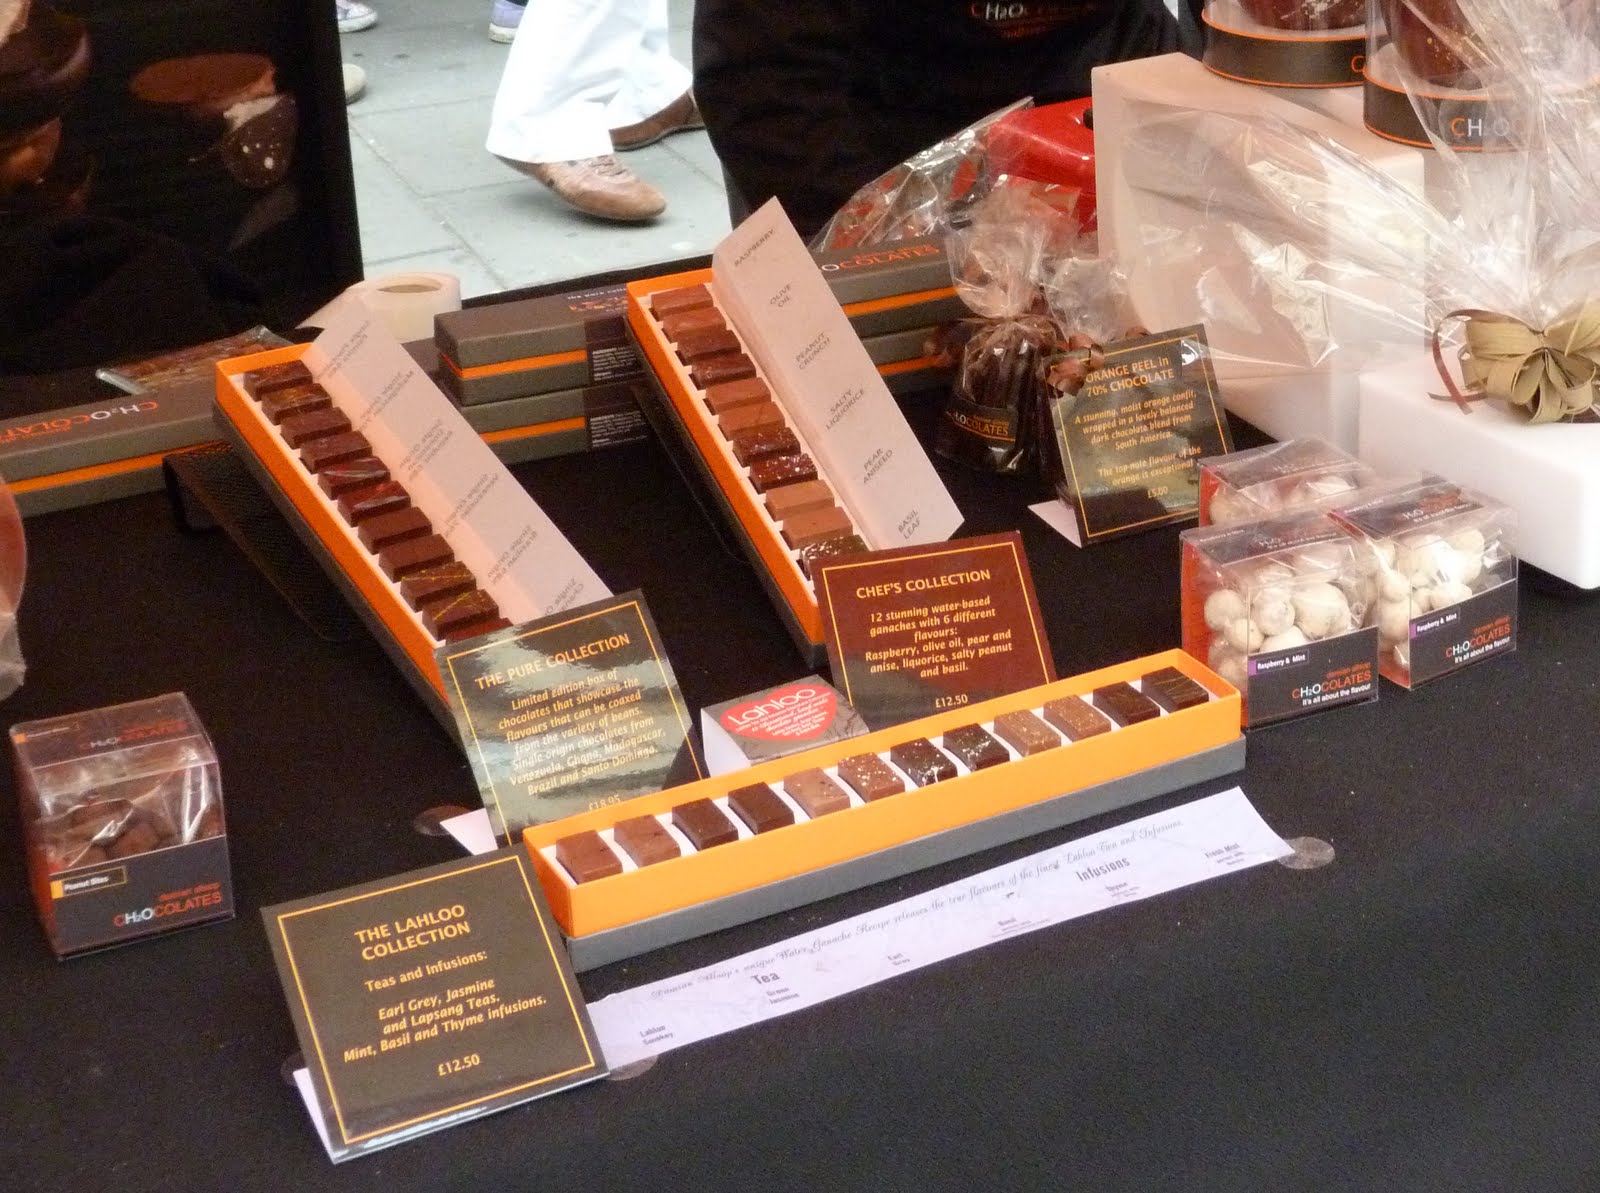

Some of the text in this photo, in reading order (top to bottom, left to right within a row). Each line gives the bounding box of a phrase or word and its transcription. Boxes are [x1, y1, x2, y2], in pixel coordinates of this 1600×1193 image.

[734, 228, 775, 267] RASPBERRY
[770, 284, 792, 306] OLIVE
[778, 296, 791, 308] OIL
[796, 332, 825, 362] PEANUT
[799, 337, 831, 370] CRUNCH
[1085, 357, 1169, 384] ORANGE PEEL in
[1086, 368, 1175, 398] 70% CHOCOLATE
[826, 388, 866, 430] LIQUORICE
[830, 388, 853, 413] SALTY
[1074, 416, 1081, 425] A
[1120, 402, 1142, 414] moist
[1143, 396, 1171, 409] orange
[1082, 419, 1117, 435] wrapped
[1118, 418, 1127, 426] in
[1135, 410, 1158, 422] lovely
[1159, 401, 1194, 417] balanced
[1091, 414, 1192, 445] dark chocolate blend from
[1115, 430, 1173, 451] South America.
[863, 450, 894, 484] ANISEED
[864, 448, 883, 471] PEAR
[1098, 468, 1113, 478] The
[1178, 449, 1187, 459] of
[1189, 446, 1201, 456] the
[1112, 459, 1194, 487] orange is exceptional
[898, 509, 919, 534] BASIL
[904, 518, 922, 540] LEAF
[855, 569, 991, 599] CHEF'S COLLECTION
[869, 608, 996, 638] ganaches with 6 different
[870, 595, 991, 623] 12 stunning water-based
[865, 629, 1012, 662] Raspberry, olive oil, pear and
[913, 627, 959, 643] flavours:
[1470, 646, 1484, 658] about
[1485, 643, 1493, 652] the
[1494, 636, 1510, 648] flavour
[474, 633, 631, 690] THE PURE COLLECTION
[870, 642, 1013, 674] anise, liquorice, salty peanut
[920, 661, 969, 678] and basil.
[1257, 659, 1285, 670] Raspberry
[1292, 654, 1305, 663] Mint
[498, 677, 640, 730] chocolates that showcase the
[511, 667, 619, 711] Limited edition box of
[935, 694, 968, 708] £12.50
[1322, 692, 1339, 702] about
[1340, 689, 1349, 697] the
[1351, 684, 1371, 694] flavour
[506, 689, 642, 744] flavours that can be coaxed
[727, 689, 816, 726] Lahloo
[511, 716, 655, 772] Single origin chocolates from
[514, 706, 643, 756] from the variety of beans.
[509, 727, 667, 787] Venezuela, Ghana, Madagascar,
[527, 745, 659, 796] Brazil and Santo Domingo.
[1075, 857, 1131, 883] Infusions
[353, 904, 466, 944] THE LAHLOO
[361, 921, 471, 961] COLLECTION
[364, 950, 488, 992] Teas and Infusions:
[750, 968, 781, 986] Tea
[378, 978, 496, 1021] Earl Grey, Jasmine
[382, 993, 501, 1035] and Lapsang Teas.
[343, 994, 548, 1064] Mint, Basil and Thyme infusions.
[437, 1053, 481, 1077] £12.50
